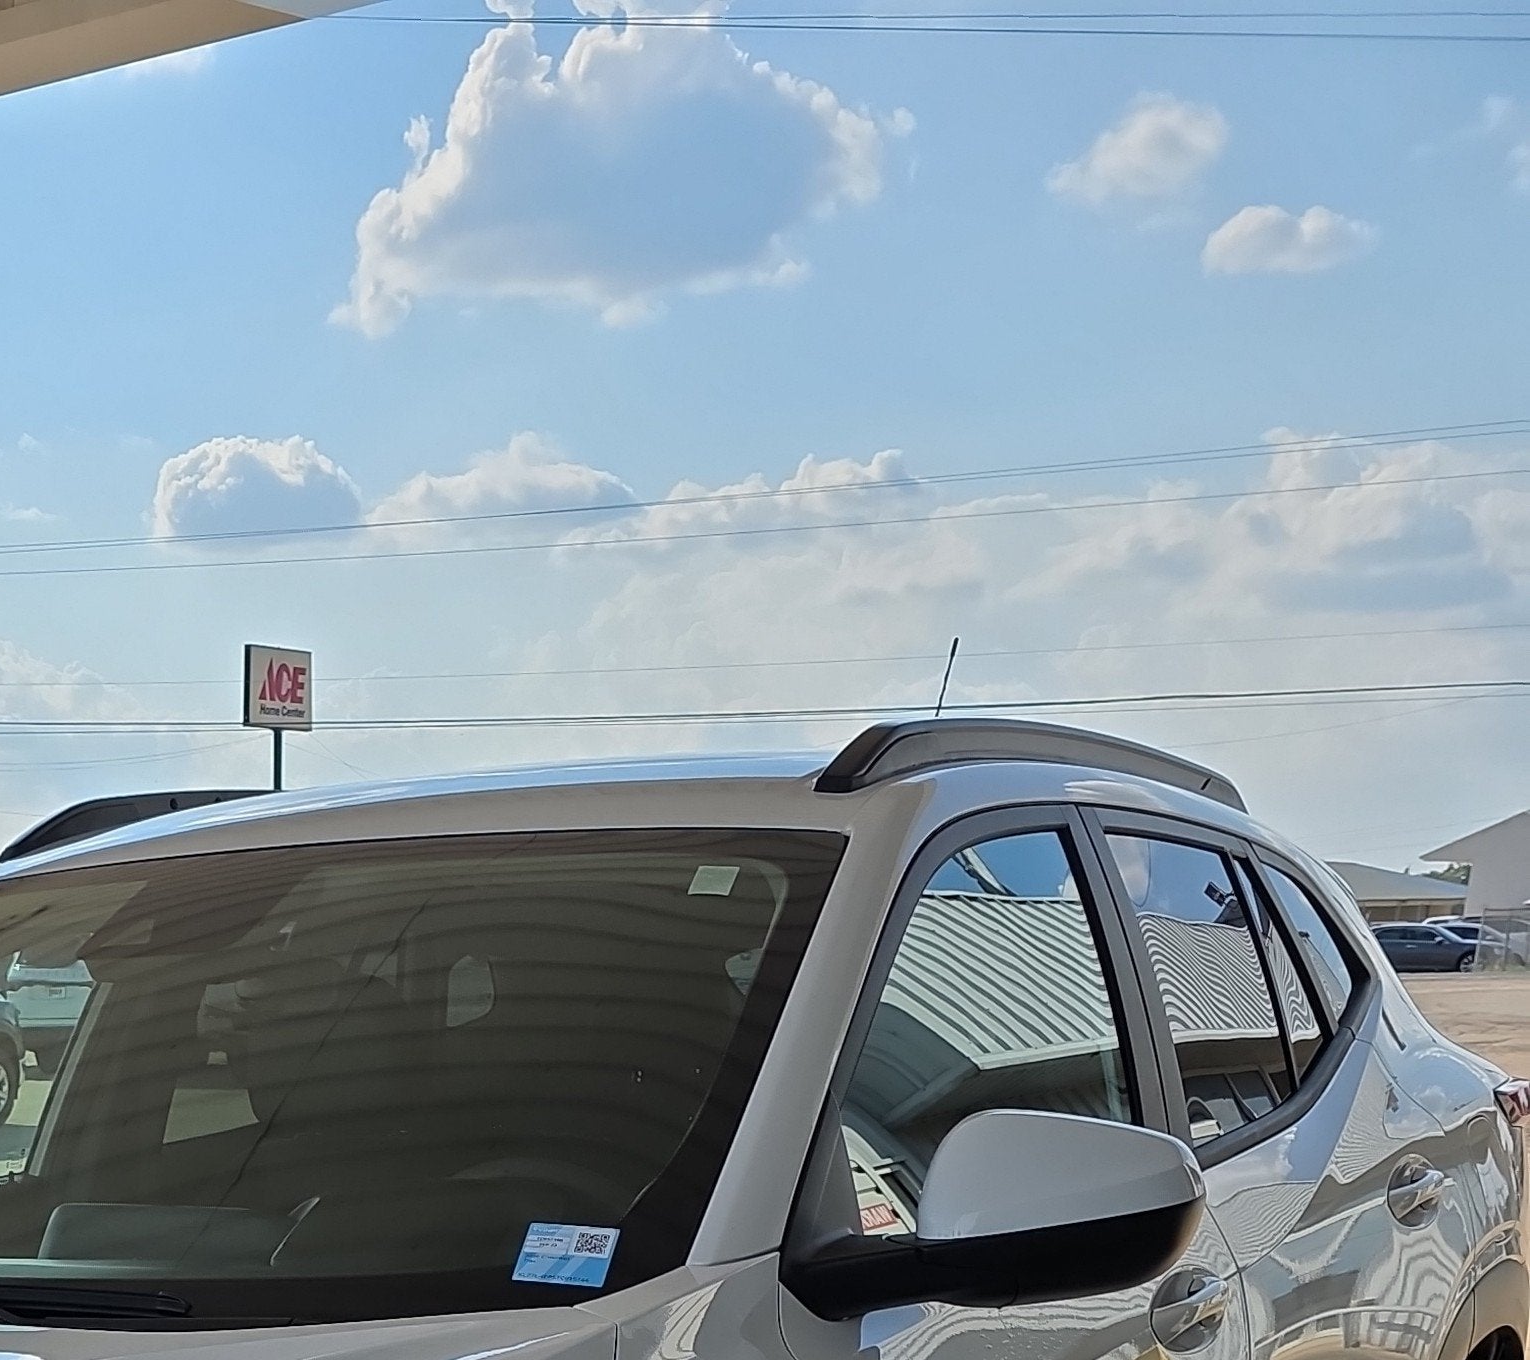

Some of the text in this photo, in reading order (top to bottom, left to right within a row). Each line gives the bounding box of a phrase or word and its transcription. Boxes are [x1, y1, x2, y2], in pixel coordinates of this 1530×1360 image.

[258, 657, 307, 704] ACE
[260, 703, 306, 718] Home Center
